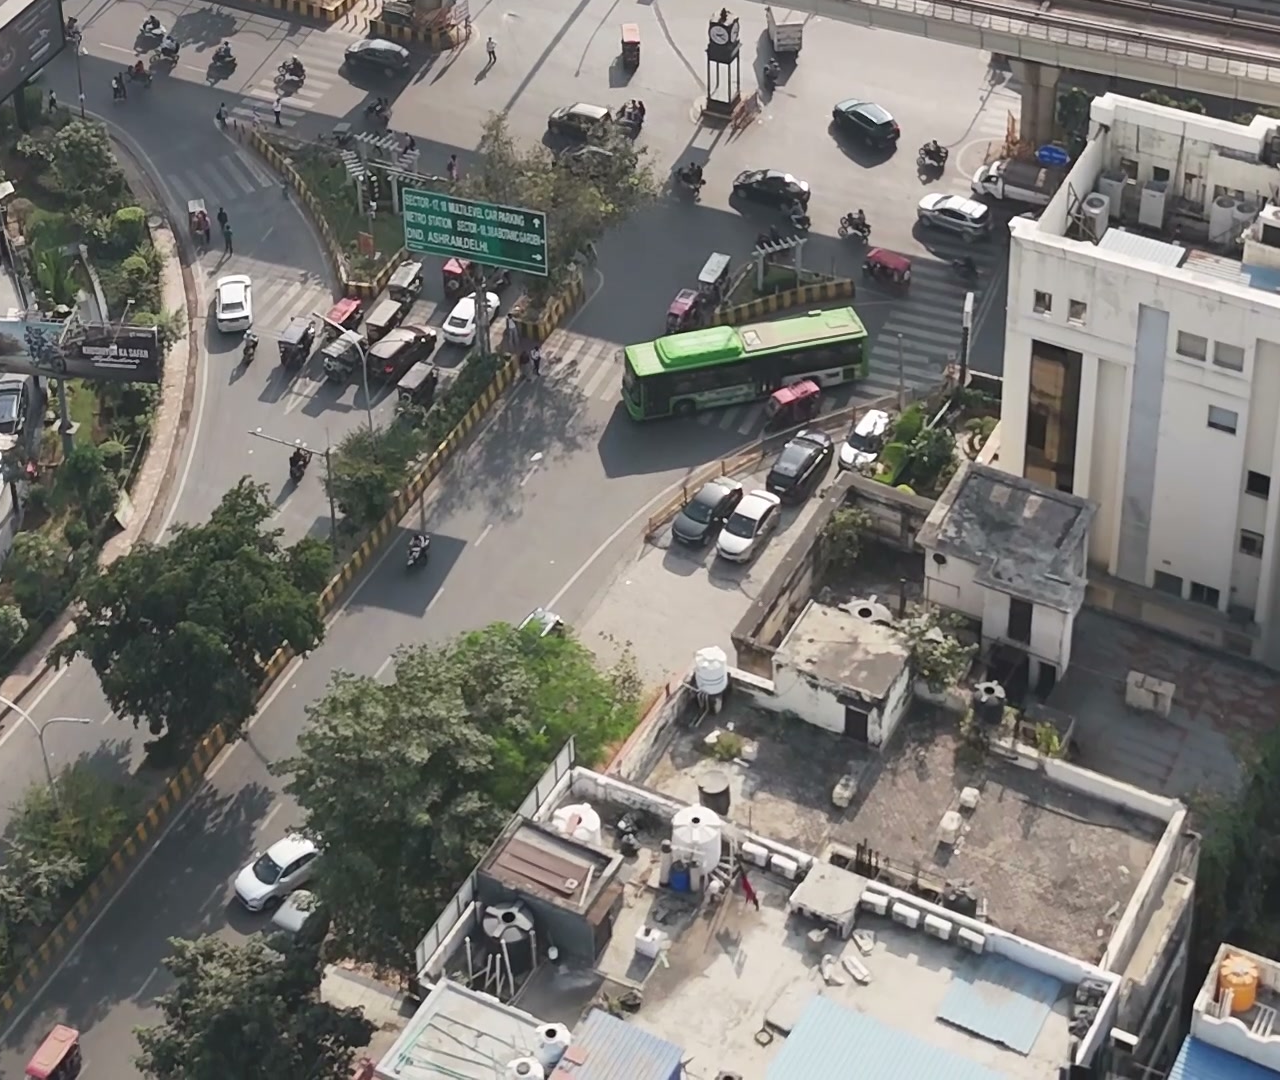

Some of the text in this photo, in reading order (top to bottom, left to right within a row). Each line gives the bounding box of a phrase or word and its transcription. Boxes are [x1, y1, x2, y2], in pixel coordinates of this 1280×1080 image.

[427, 214, 453, 229] STATION
[484, 208, 498, 220] CAR
[498, 211, 525, 227] PARKING
